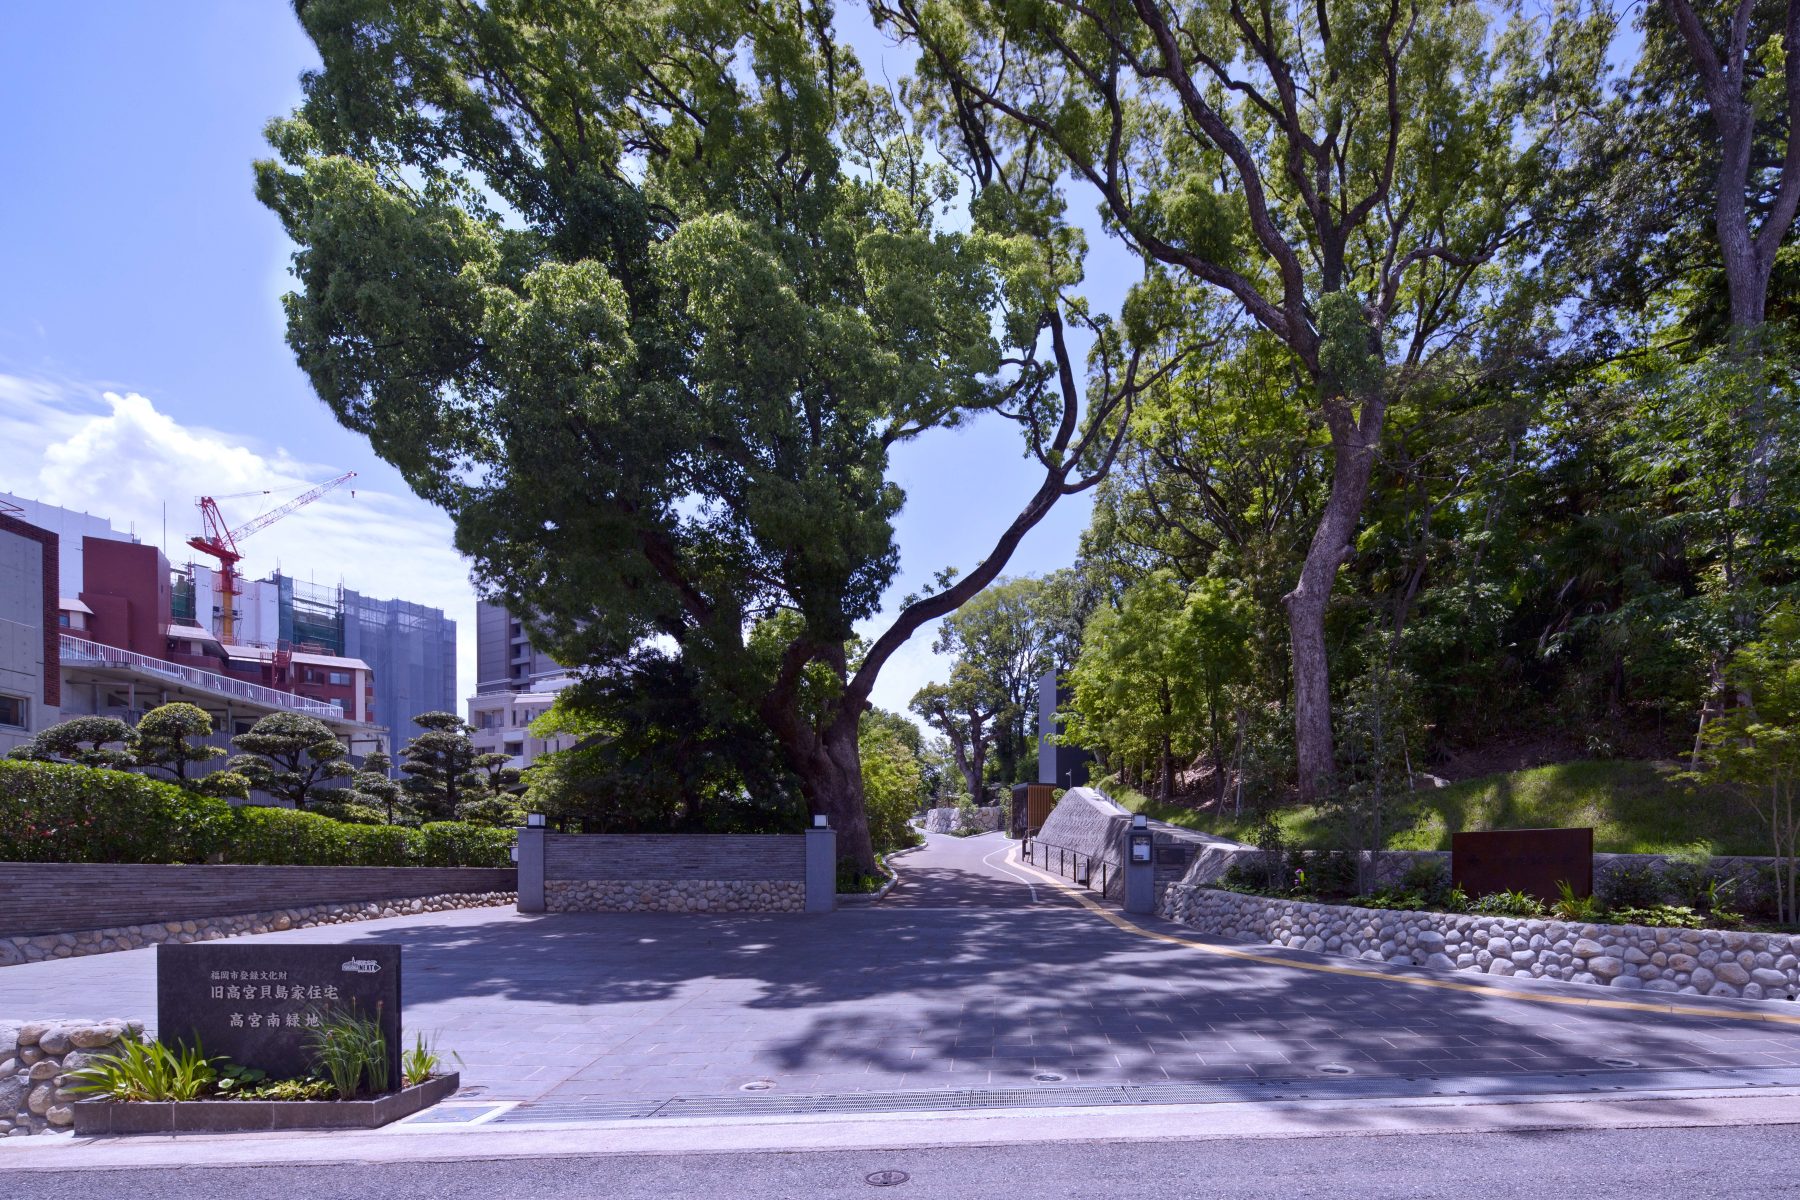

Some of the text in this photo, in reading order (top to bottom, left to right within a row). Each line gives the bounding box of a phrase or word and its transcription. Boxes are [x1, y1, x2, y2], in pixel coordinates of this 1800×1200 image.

[210, 970, 288, 981] 福岡市登録文化財
[211, 984, 339, 1000] 旧高宮貝島家住宅
[229, 1012, 320, 1028] 高宮南緑地
